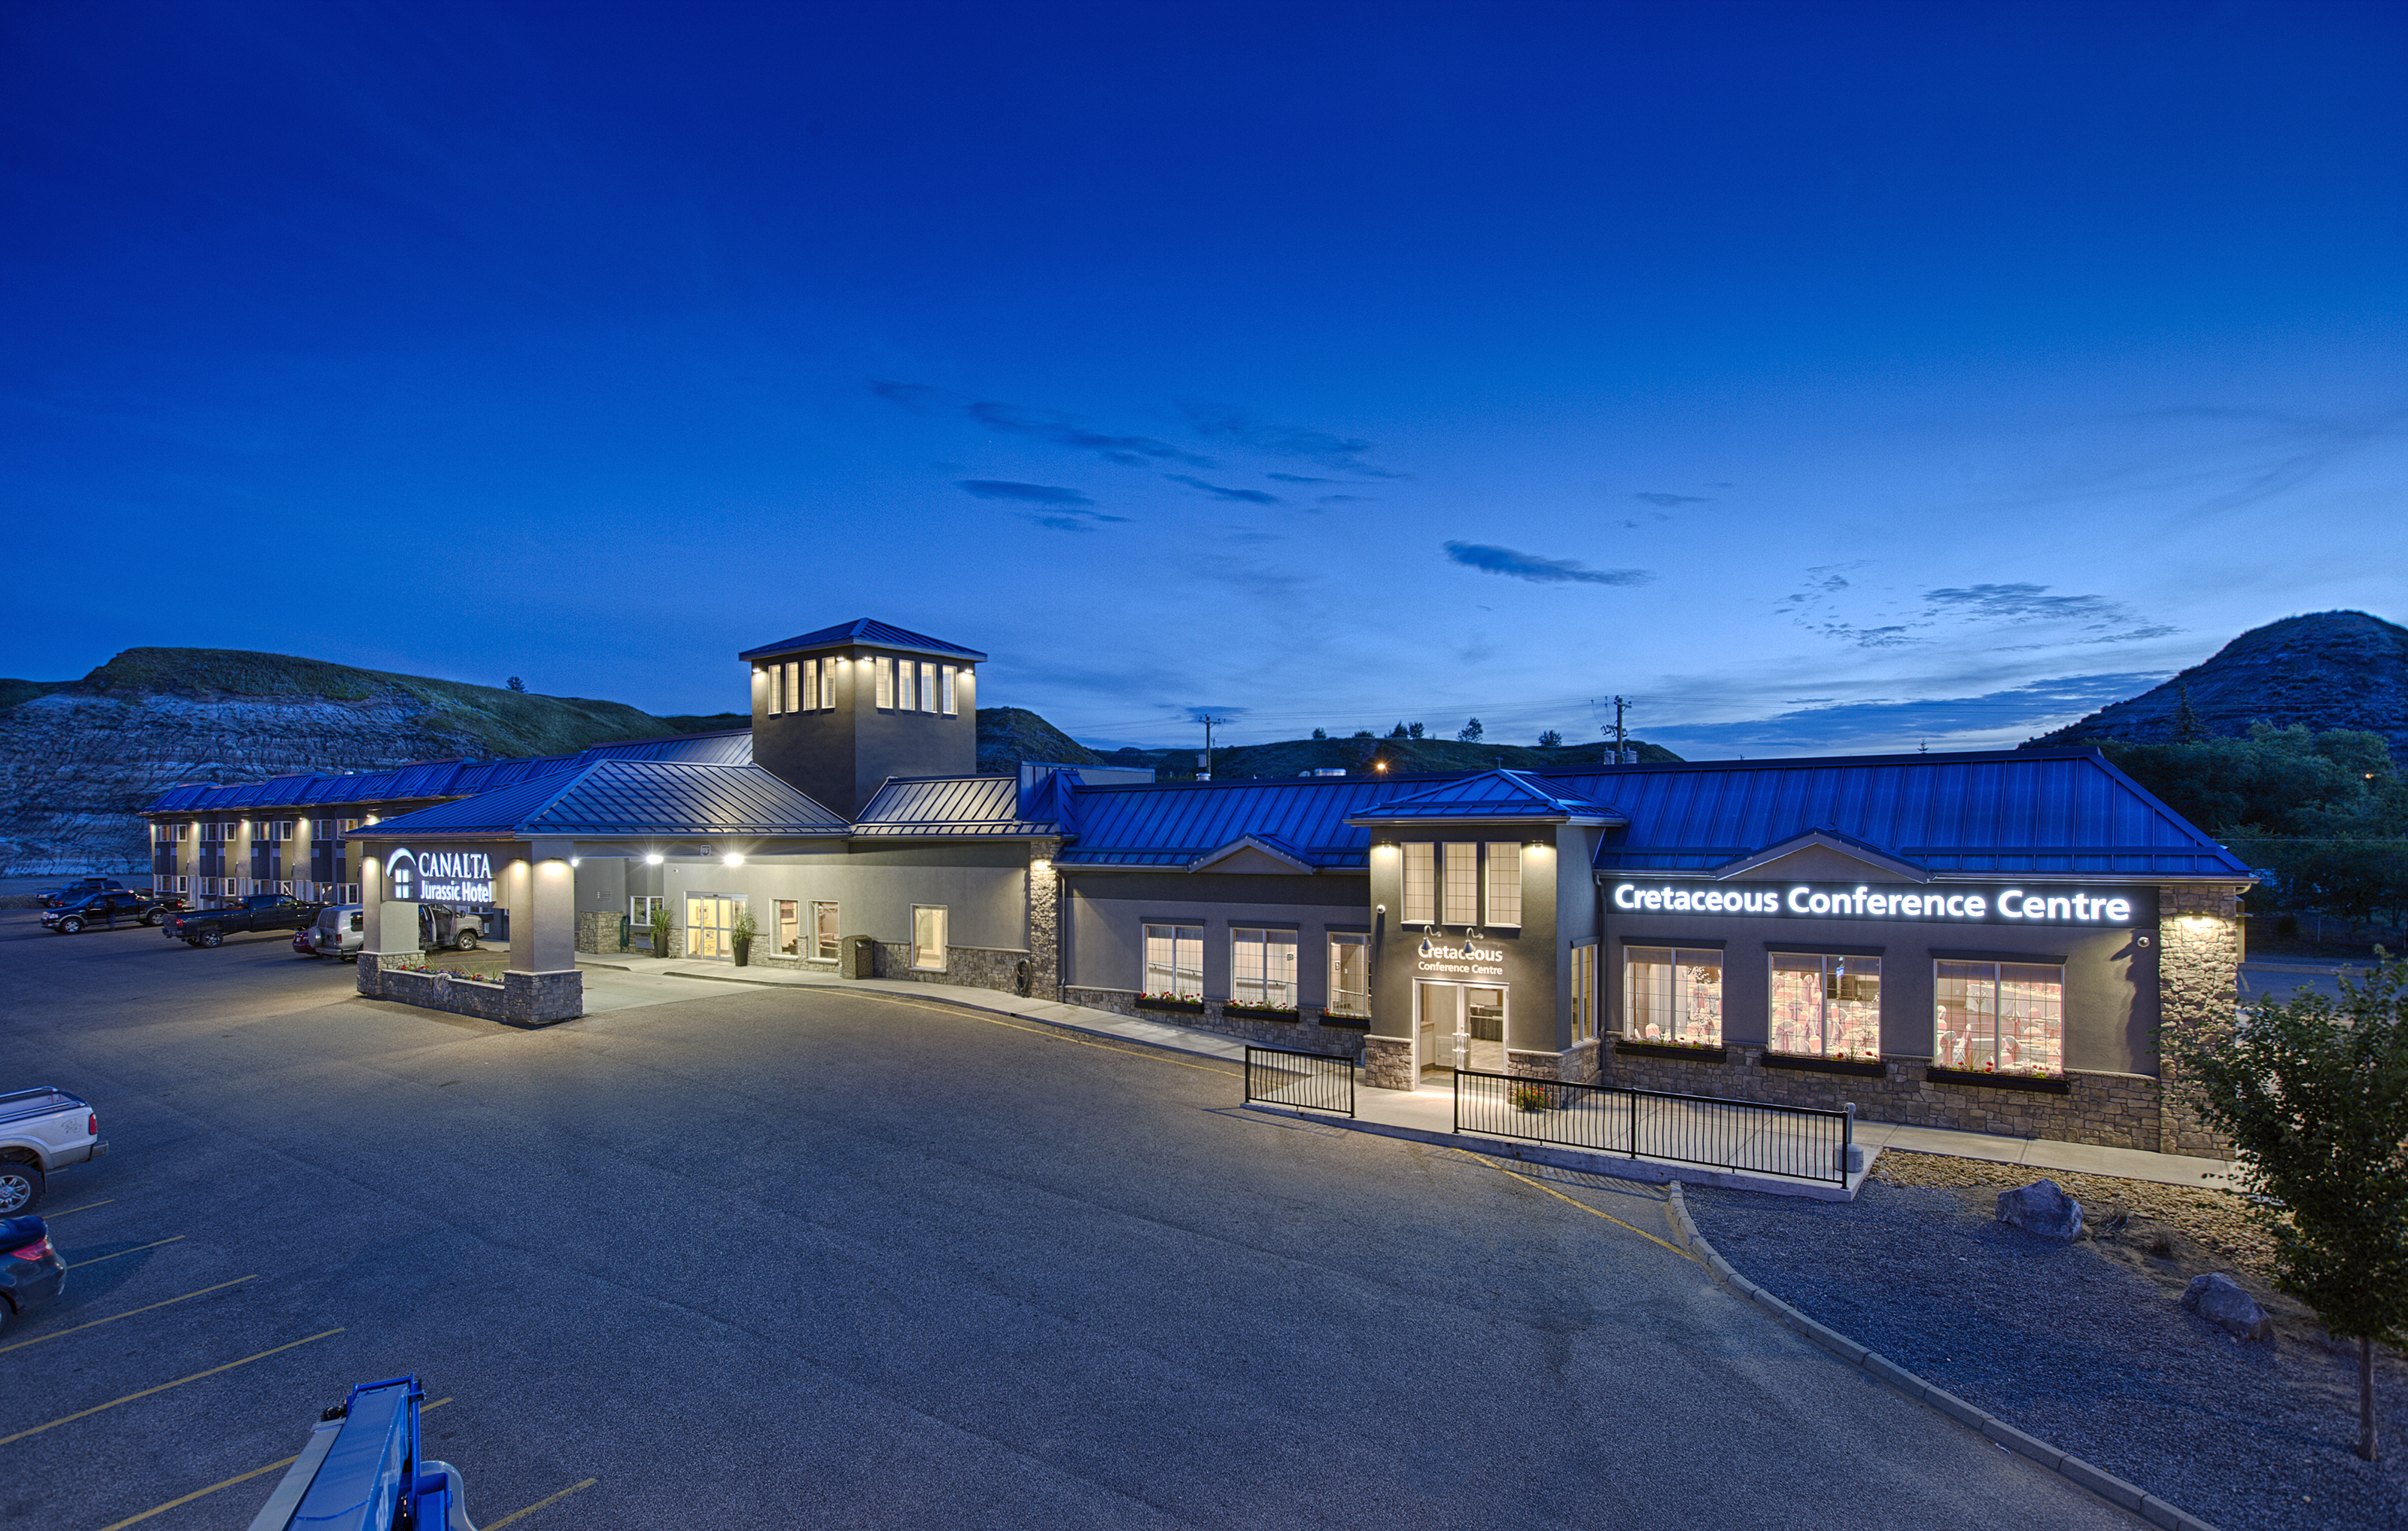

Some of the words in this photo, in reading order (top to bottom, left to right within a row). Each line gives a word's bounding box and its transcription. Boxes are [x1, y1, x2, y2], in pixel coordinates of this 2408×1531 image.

[418, 852, 493, 879] CANALTA
[420, 880, 461, 901] Jurassic
[461, 881, 492, 902] Hotel
[1615, 884, 1779, 912] Cretaceous
[1788, 886, 1987, 917] Conference
[1997, 890, 2130, 921] Centre
[1418, 961, 1470, 973] Conference
[1471, 964, 1503, 976] Centre
